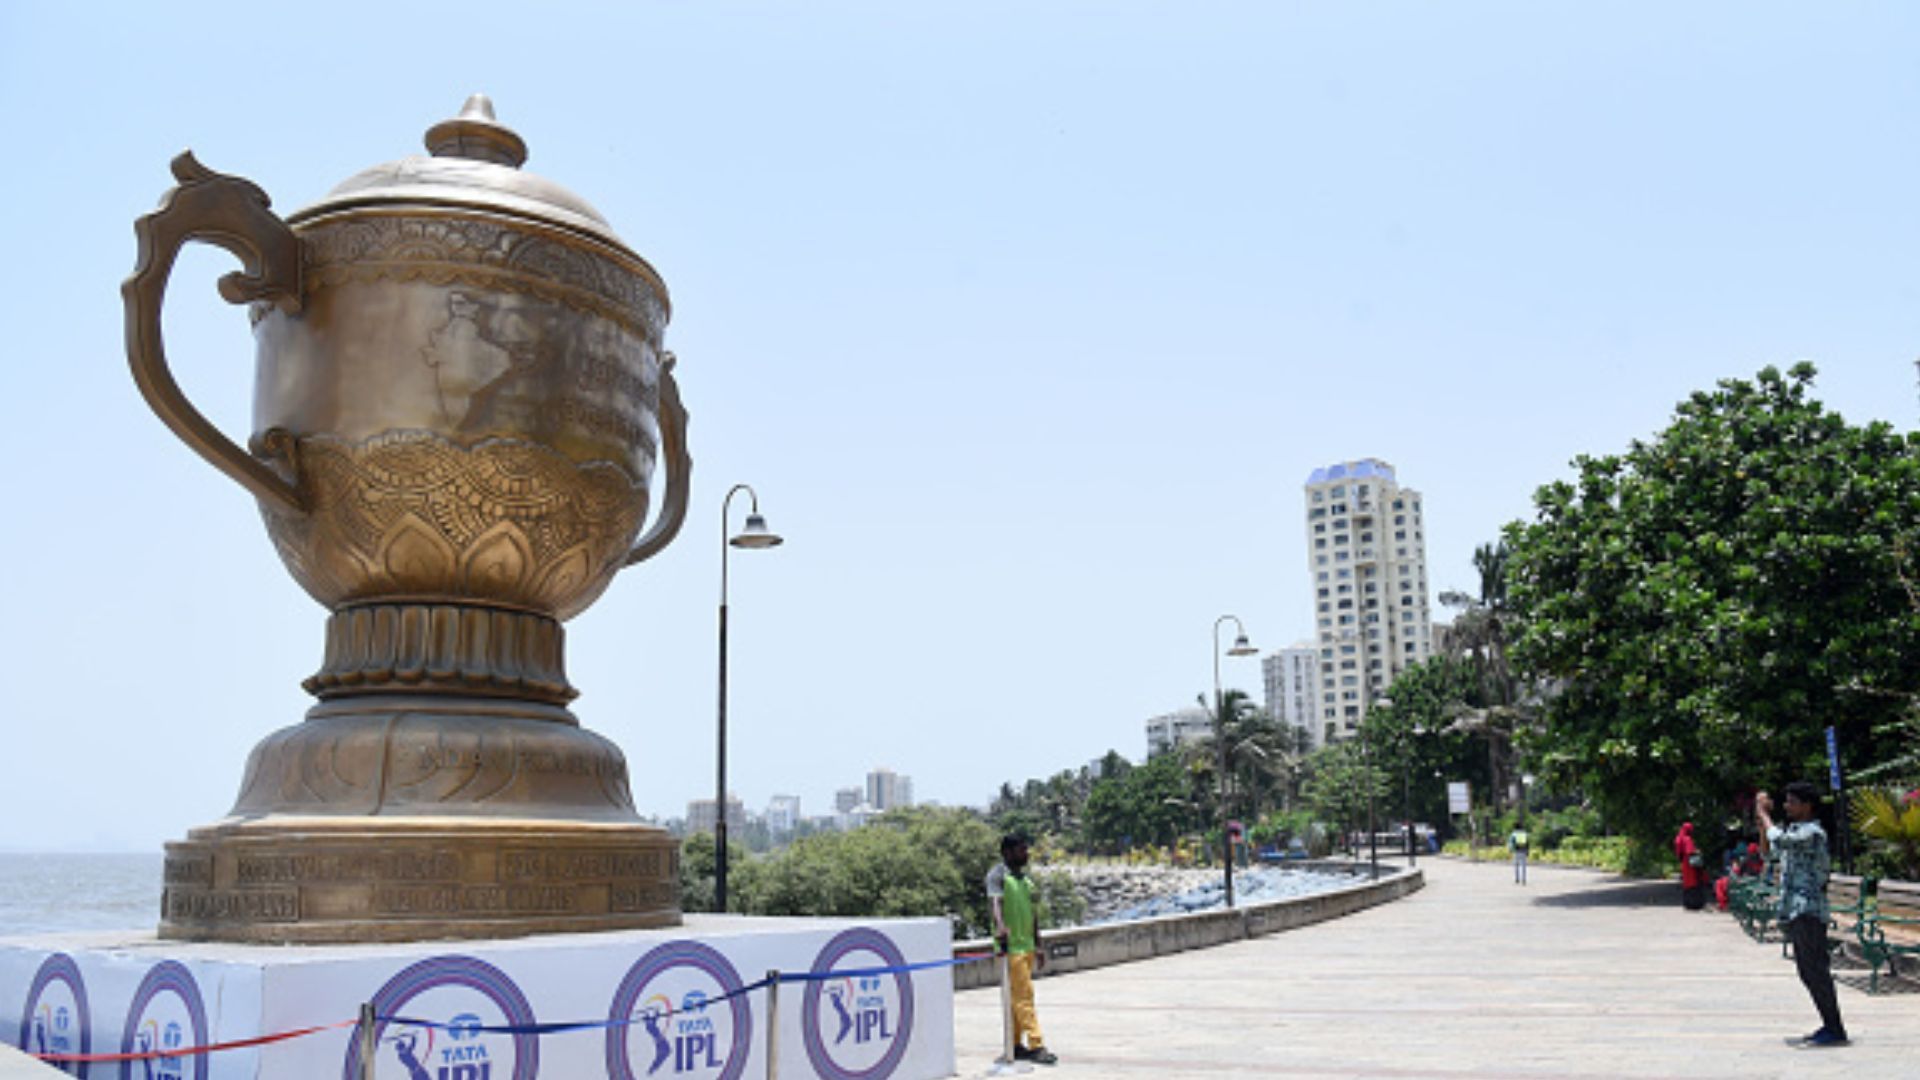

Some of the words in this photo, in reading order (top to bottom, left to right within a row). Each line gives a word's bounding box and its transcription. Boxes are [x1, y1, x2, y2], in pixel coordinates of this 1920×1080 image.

[856, 1008, 893, 1043] IPL
[441, 1045, 488, 1063] TATA
[675, 1033, 723, 1073] IPL
